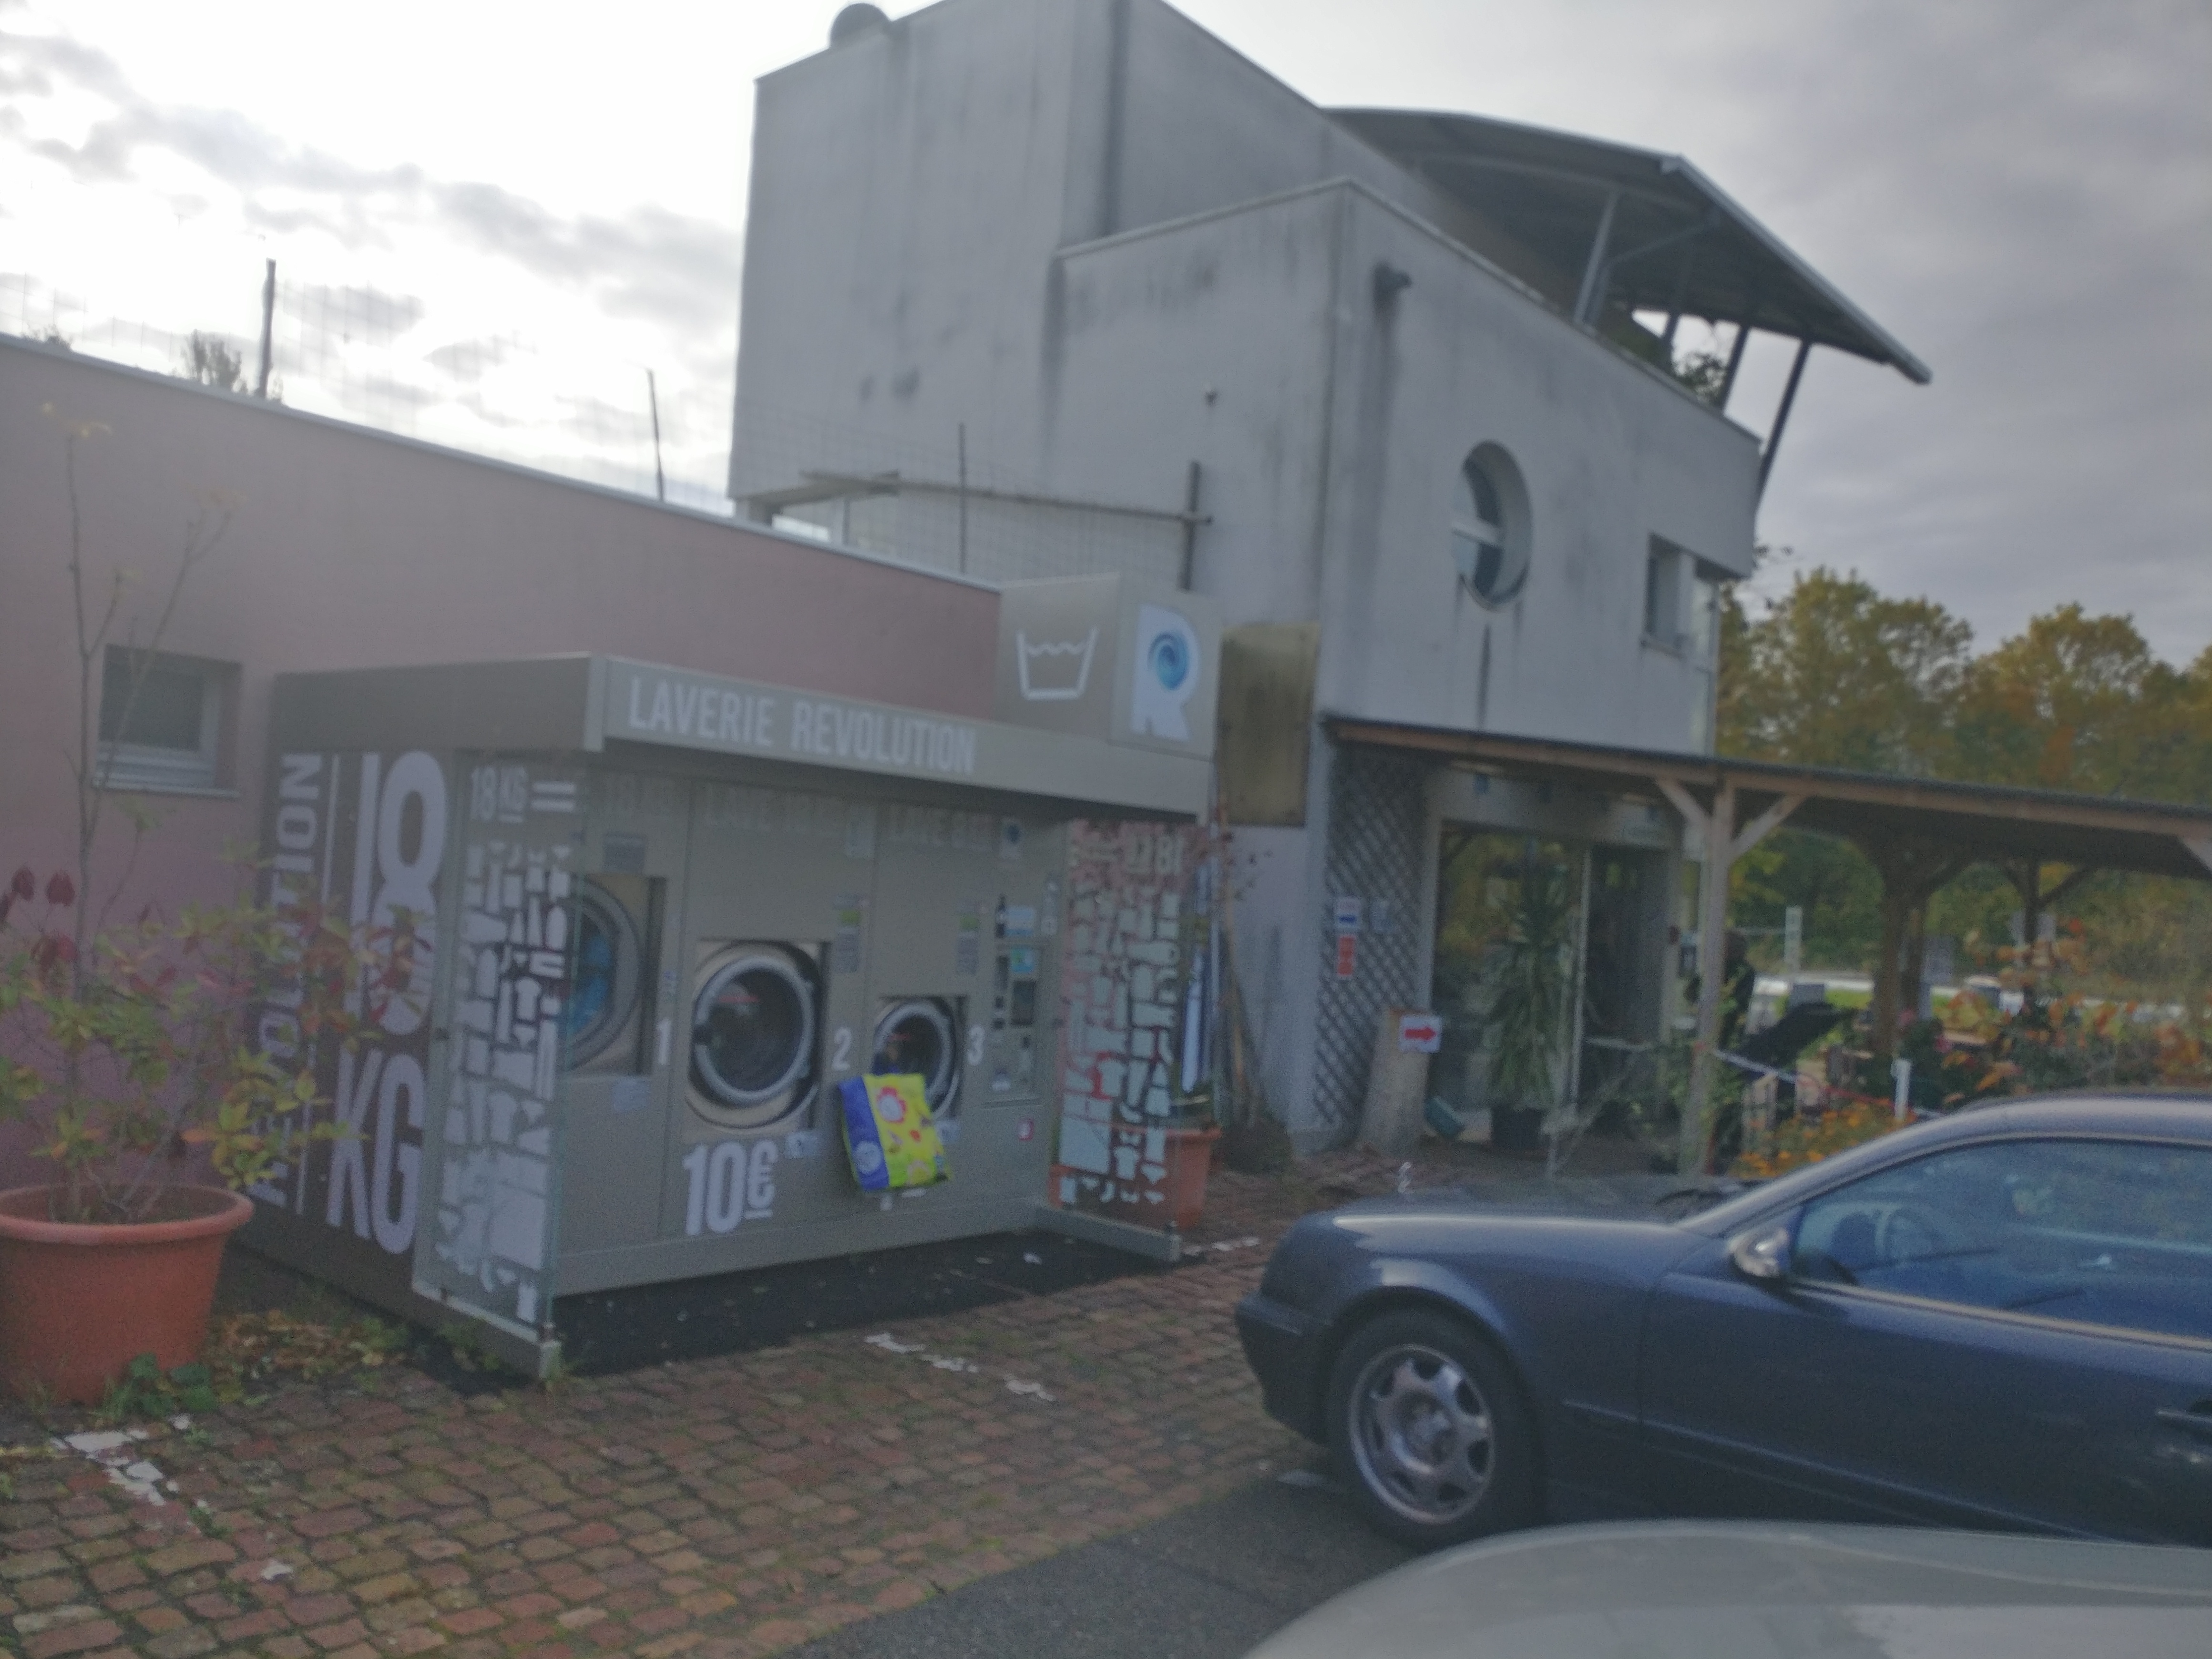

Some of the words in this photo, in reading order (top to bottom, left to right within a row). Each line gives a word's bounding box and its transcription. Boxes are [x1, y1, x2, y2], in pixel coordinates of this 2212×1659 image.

[628, 675, 778, 748] LAVERIE
[789, 698, 976, 776] REVOLUTION
[343, 750, 447, 1034] 18
[656, 1017, 671, 1065] 1
[832, 1026, 852, 1071] 2
[967, 1025, 985, 1066] 3
[326, 1046, 426, 1254] KG
[682, 1140, 779, 1236] 10€
